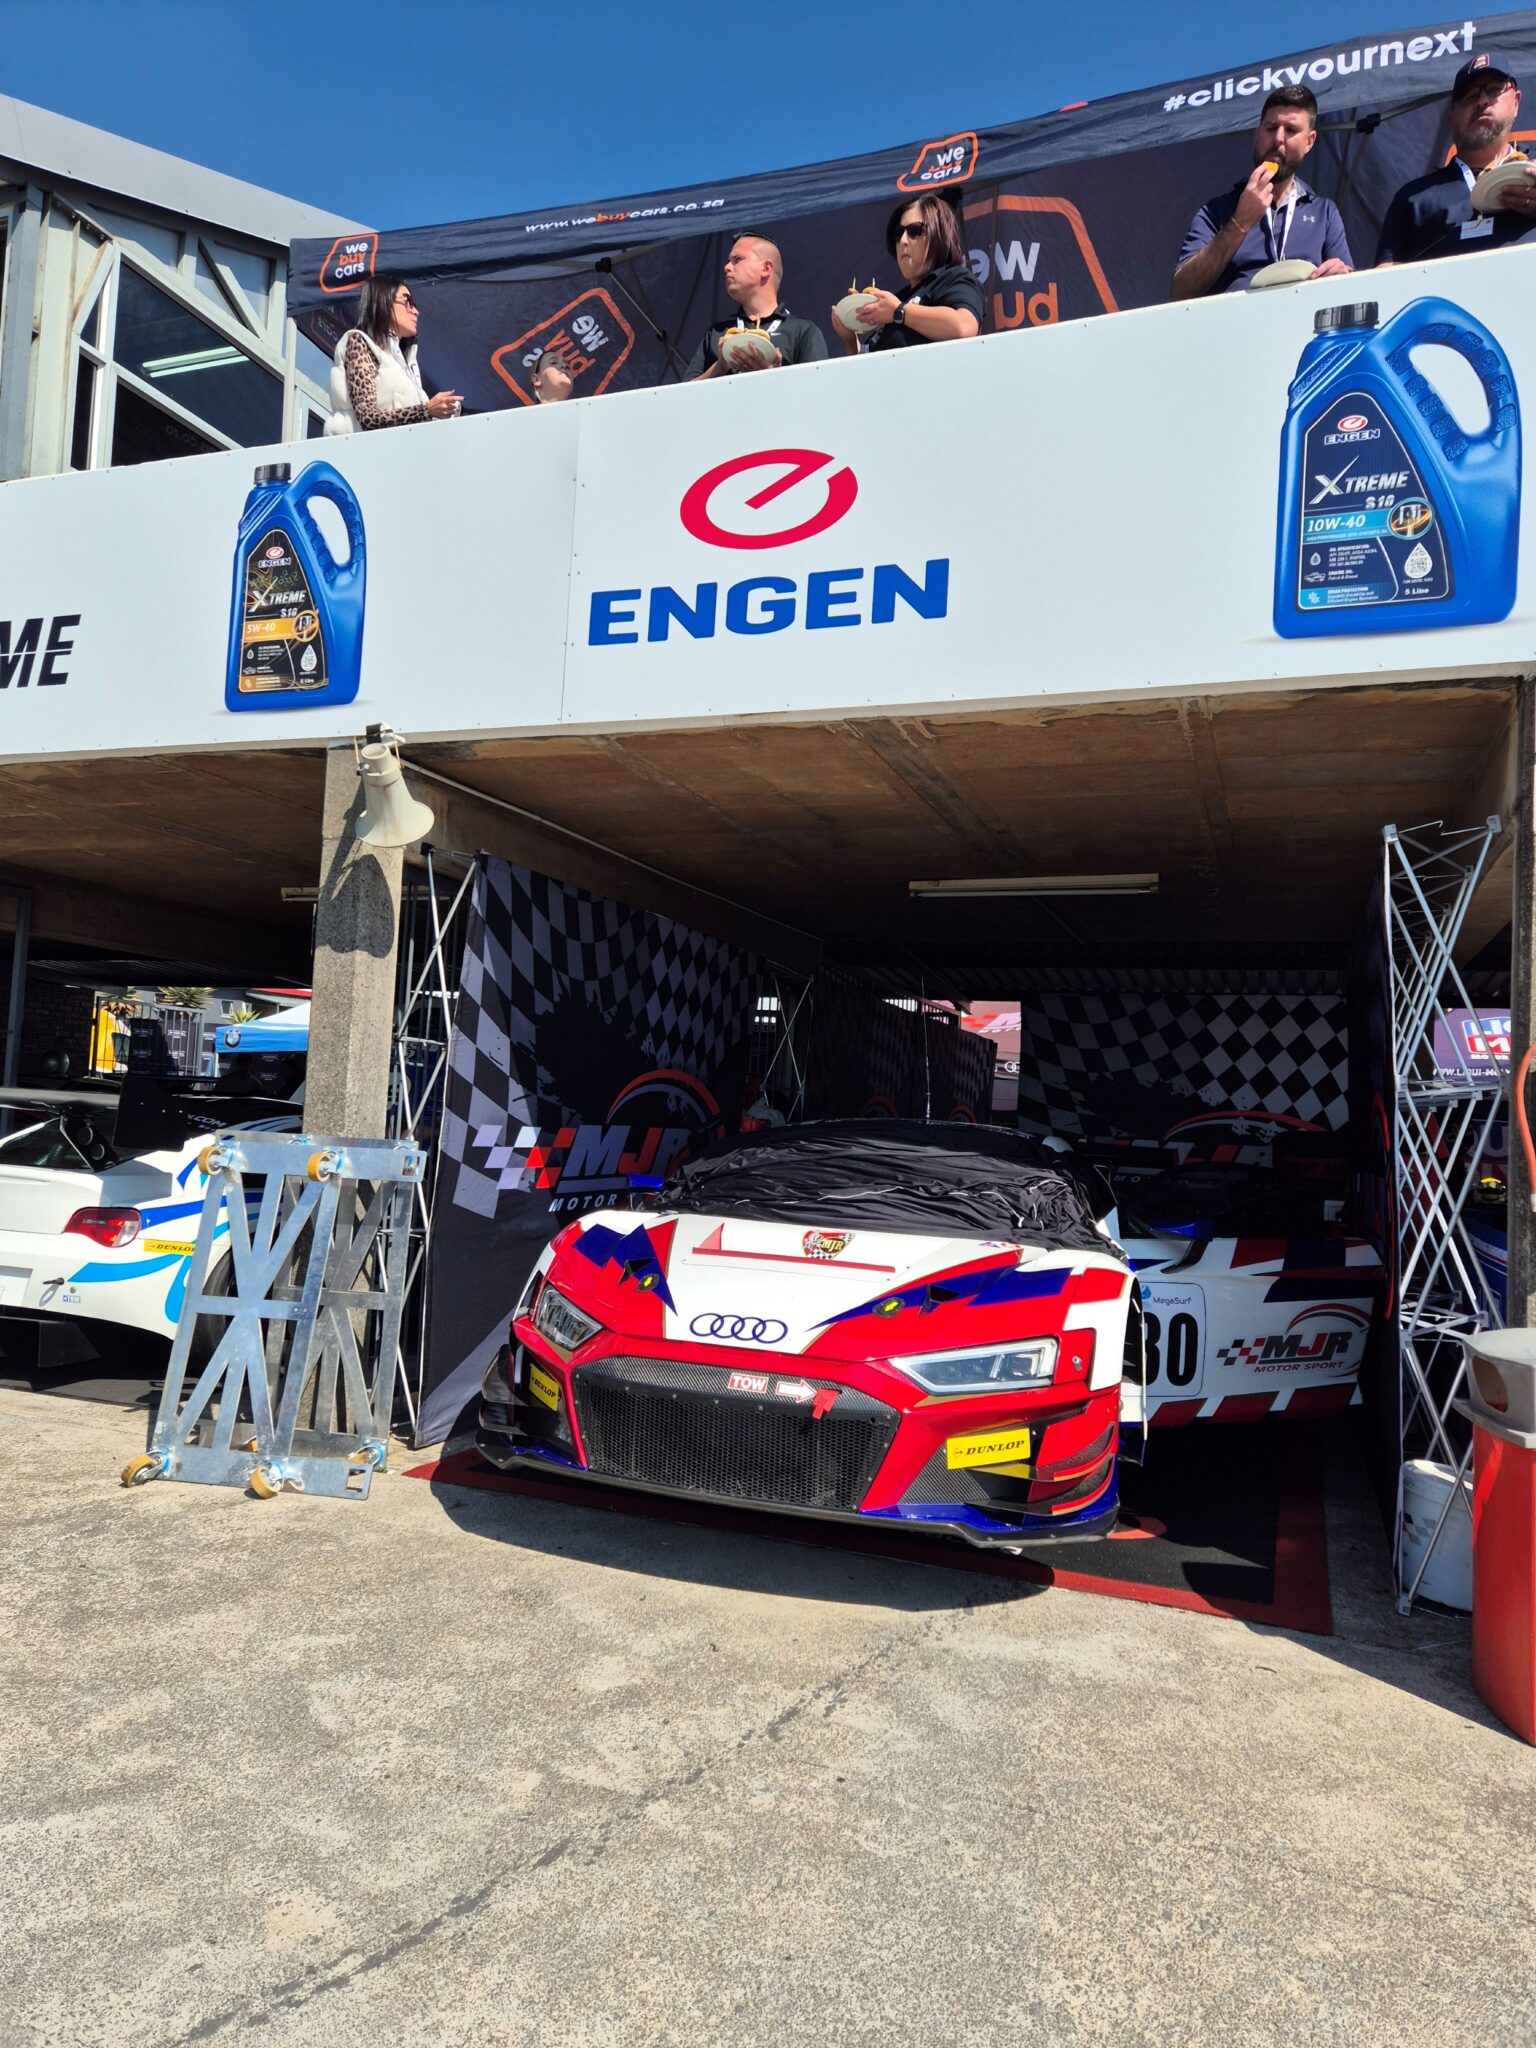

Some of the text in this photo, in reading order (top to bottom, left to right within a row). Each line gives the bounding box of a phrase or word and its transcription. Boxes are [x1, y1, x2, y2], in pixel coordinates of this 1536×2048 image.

[936, 146, 964, 166] we
[525, 198, 724, 233] www.webuycars.co.za
[345, 242, 369, 254] we
[335, 262, 365, 279] cars
[1324, 428, 1381, 445] ENGEN
[1309, 455, 1410, 505] XTREME
[1307, 514, 1366, 533] 10W-40
[248, 577, 307, 613] XTREME
[588, 558, 950, 646] ENGEN
[247, 622, 276, 634] 5W-40
[0, 614, 82, 689] ME
[559, 1124, 693, 1178] MJR
[547, 1193, 619, 1213] MOTOR
[821, 1239, 844, 1252] MJR
[1153, 1297, 1192, 1306] MegaSurf
[1260, 1331, 1353, 1360] MJR
[1254, 1361, 1344, 1373] MOTOR SPORT
[732, 1375, 766, 1391] TOW
[965, 1440, 1025, 1456] DUNLOP
